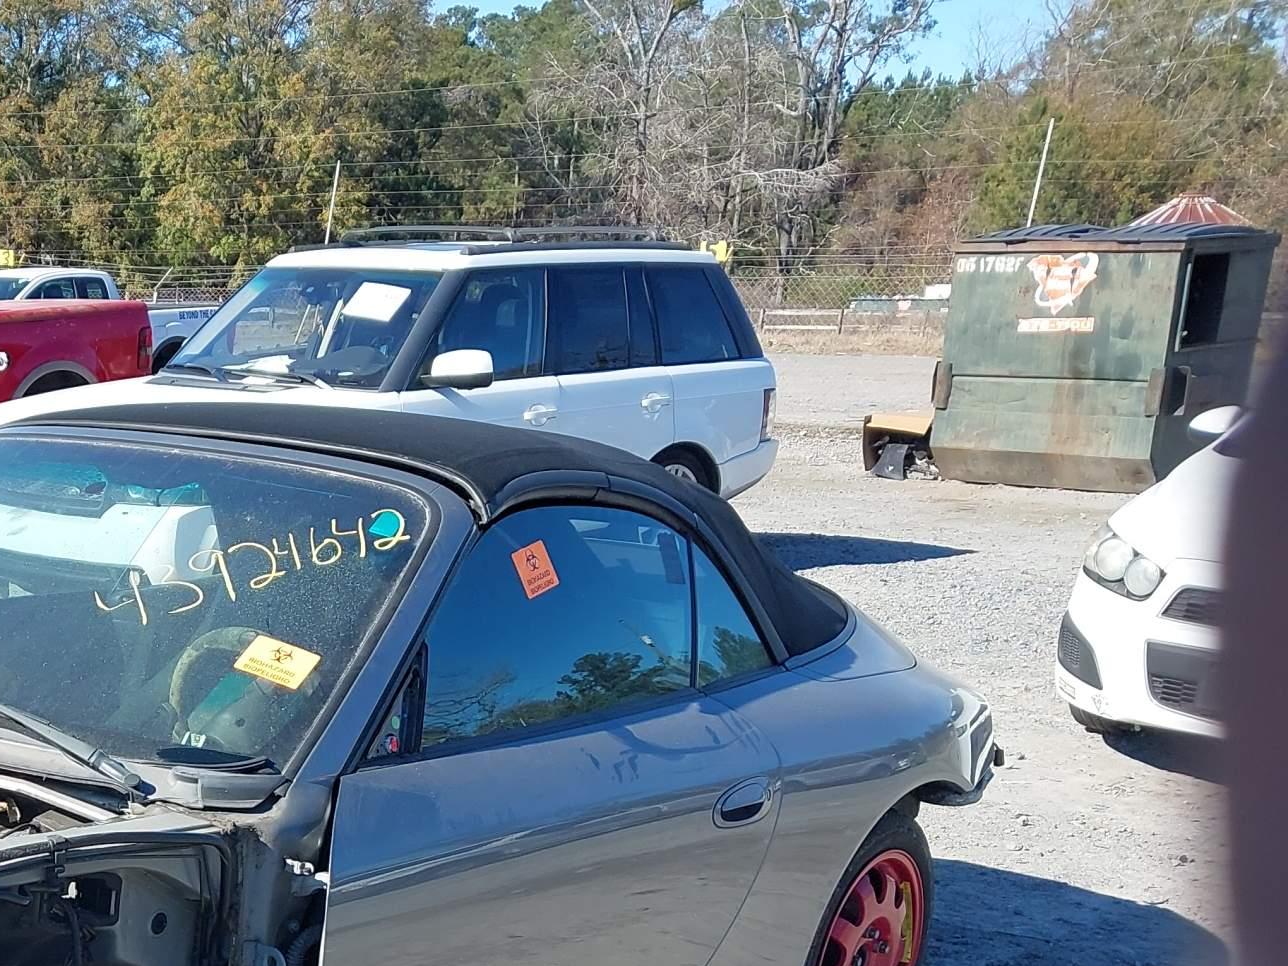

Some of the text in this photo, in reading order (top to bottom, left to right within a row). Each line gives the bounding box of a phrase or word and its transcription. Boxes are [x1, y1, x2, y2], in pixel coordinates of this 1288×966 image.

[178, 310, 199, 320] BEYOND
[199, 309, 209, 319] THE
[93, 508, 411, 626] 43924642
[248, 656, 296, 678] BIOHAZARD
